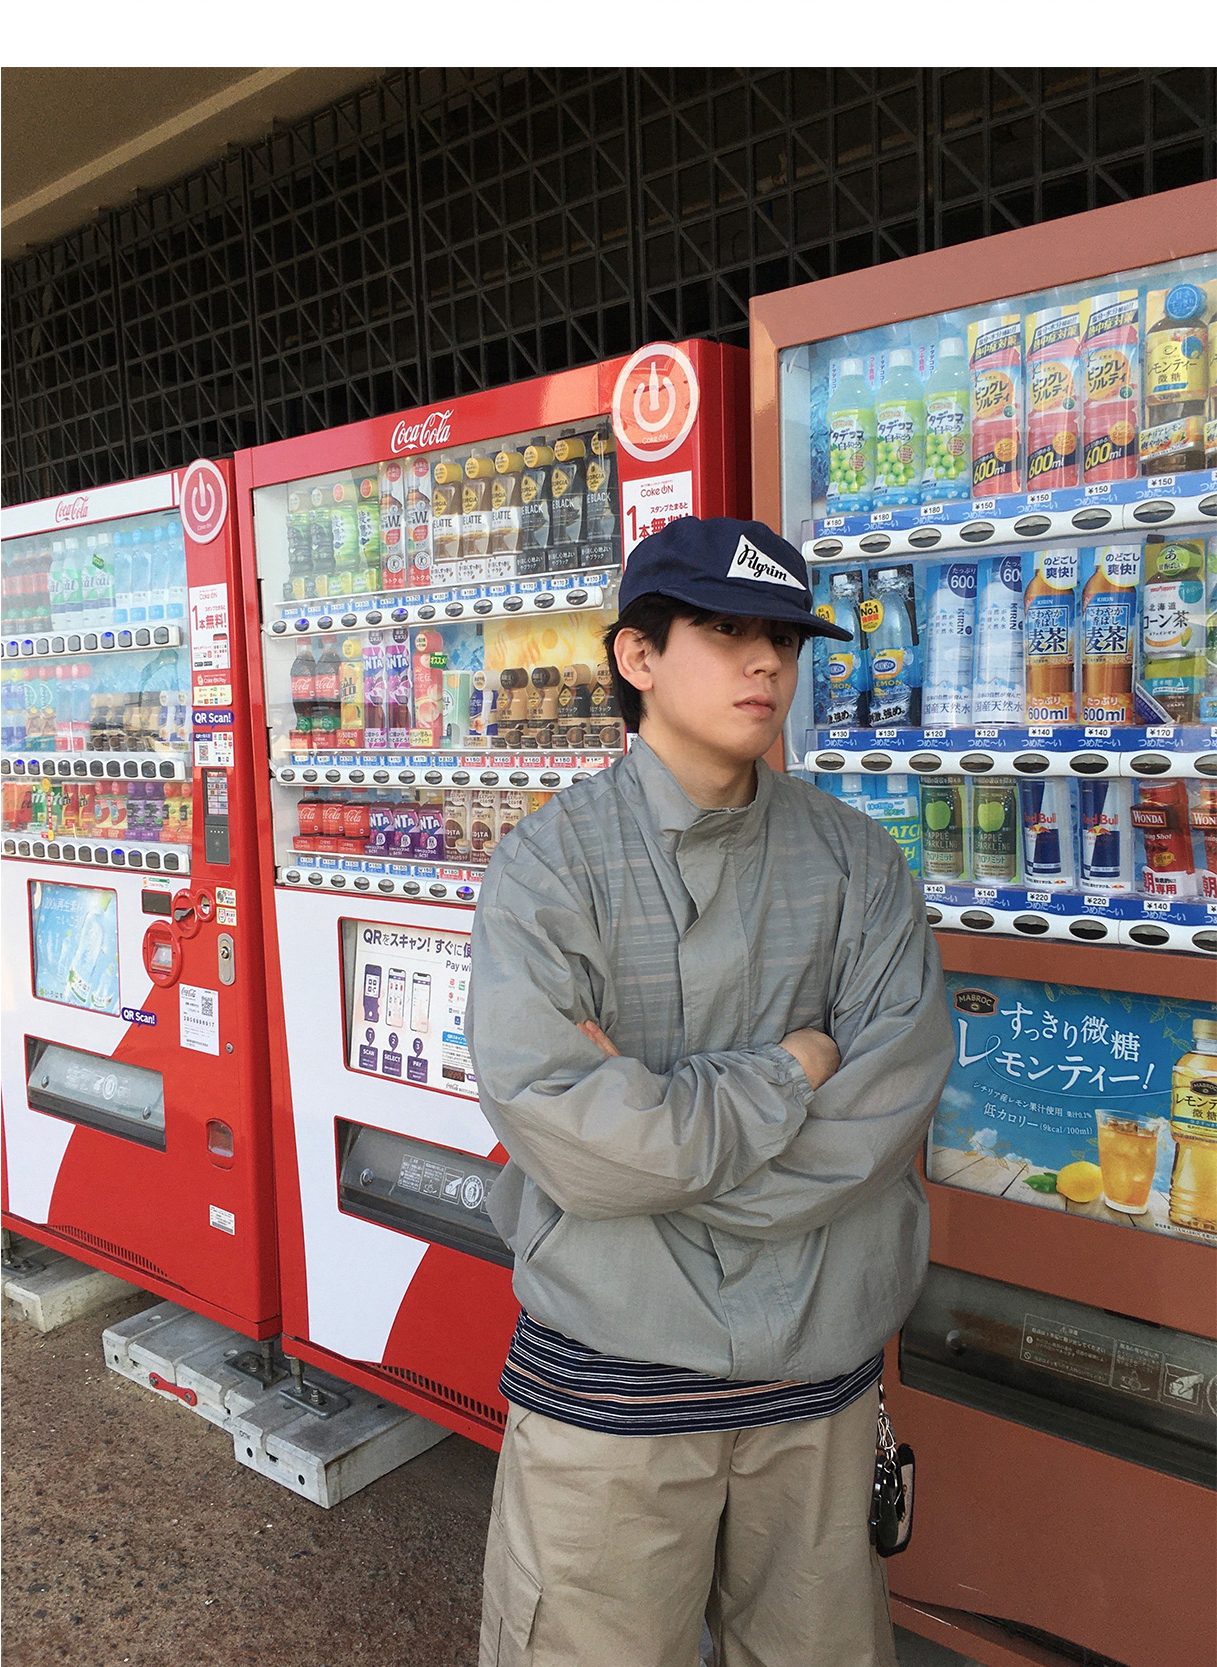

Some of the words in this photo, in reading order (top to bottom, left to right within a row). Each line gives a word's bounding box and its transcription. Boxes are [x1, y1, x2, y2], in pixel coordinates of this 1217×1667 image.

[1088, 361, 1125, 380] ピングレ
[1032, 371, 1068, 391] ピングレ
[1089, 372, 1125, 391] ソルティ
[1158, 373, 1181, 384] 微糖
[975, 381, 1008, 398] ピングレ
[1034, 384, 1069, 402] ソルティ
[976, 393, 1009, 410] ソルティ
[390, 409, 454, 453] Coca-Cola
[1085, 442, 1122, 470] 600ml
[974, 459, 1005, 482] 600ml
[1028, 452, 1065, 477] 600ml
[640, 487, 660, 498] Coke
[662, 485, 673, 494] ON
[1088, 486, 1109, 494] ¥150
[1030, 494, 1049, 502] ¥150
[55, 497, 89, 523] Coca-Cola
[975, 502, 993, 510] ¥150
[738, 544, 787, 581] Pilgrim
[1044, 557, 1077, 566] のどごし
[1105, 553, 1140, 563] のどごし
[1046, 568, 1074, 579] 爽快!
[1107, 565, 1136, 575] 爽快!
[950, 575, 975, 589] 600
[861, 608, 879, 617] No.1
[1149, 602, 1176, 611] 北海道
[1029, 627, 1066, 652] 麦茶
[1085, 626, 1127, 652] 麦茶
[1031, 697, 1061, 705] たっぷり
[1087, 696, 1118, 705] たっぷり
[195, 712, 207, 723] QR
[208, 712, 231, 722] Scan!
[1028, 707, 1068, 721] 600ml
[1083, 707, 1124, 722] 600ml
[925, 730, 943, 738] ¥120
[1031, 728, 1050, 736] ¥140
[1088, 728, 1107, 736] ¥140
[1149, 729, 1171, 737] ¥170
[1038, 813, 1056, 823] Bull
[1100, 813, 1118, 825] Bull
[1133, 810, 1164, 824] WONDA
[980, 833, 1002, 842] APPLE
[1030, 893, 1048, 901] ¥220
[1087, 897, 1107, 905] ¥220
[363, 928, 430, 952] QRをスキャン!
[958, 993, 992, 1007] MABROC
[124, 1010, 134, 1020] QR
[136, 1012, 155, 1024] Scan!
[1001, 1001, 1141, 1063] すっきり微糖
[957, 1018, 1155, 1092] レモンティー!
[983, 1102, 1038, 1128] 低カロリー
